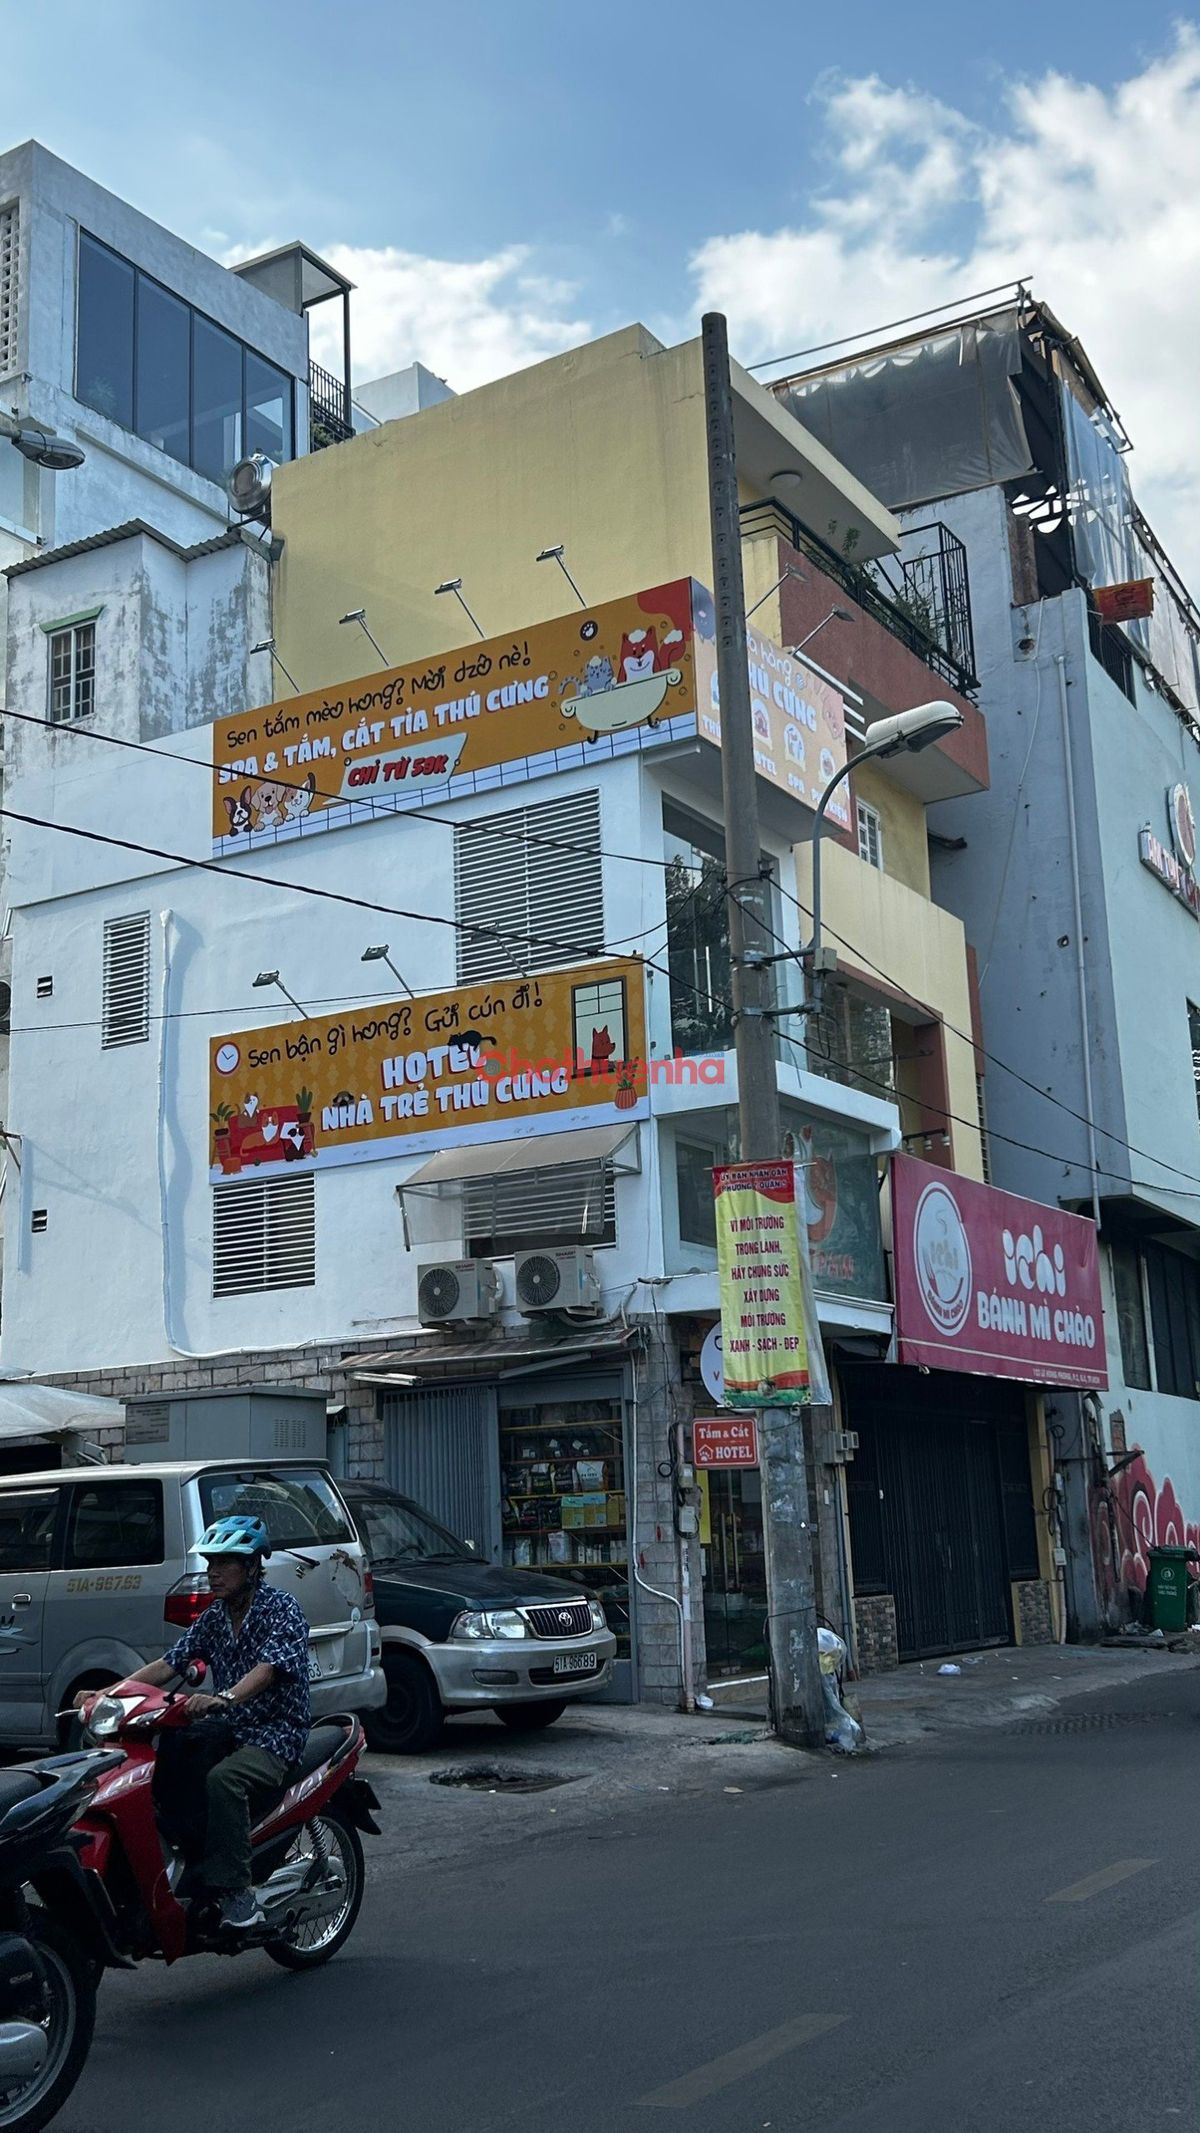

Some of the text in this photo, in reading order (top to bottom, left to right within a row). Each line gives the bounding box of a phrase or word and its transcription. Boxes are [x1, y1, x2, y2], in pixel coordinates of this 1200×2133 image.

[227, 641, 531, 748] Sen tắm mèo hong? Mời dzô nè!
[217, 675, 549, 784] SPA & TẮM, CẮT TỈA THÚ CƯNG
[348, 754, 449, 786] CHỈ TỪ 59K
[248, 1047, 281, 1068] Sen
[285, 1033, 321, 1063] bận
[327, 1024, 346, 1056] gì
[352, 1006, 412, 1043] hong?
[425, 1002, 459, 1032] Gửi
[468, 995, 505, 1021] cún
[381, 1043, 487, 1090] HOTEL
[321, 1067, 569, 1132] NHÀ TRẺ THÚ CƯNG
[730, 1213, 785, 1232] VÌ MÔI TRƯỜNG
[735, 1242, 759, 1256] TRONG
[747, 1264, 772, 1279] CHUNG
[740, 1310, 786, 1328] MÔI TRƯỜNG
[977, 1287, 1027, 1336] BÁNH
[1029, 1298, 1051, 1341] MÌ
[1054, 1305, 1095, 1348] CHẢO
[730, 1339, 750, 1353] XANH
[757, 1337, 777, 1354] SẠCH
[723, 1430, 729, 1438] &
[715, 1445, 753, 1459] HOTEL
